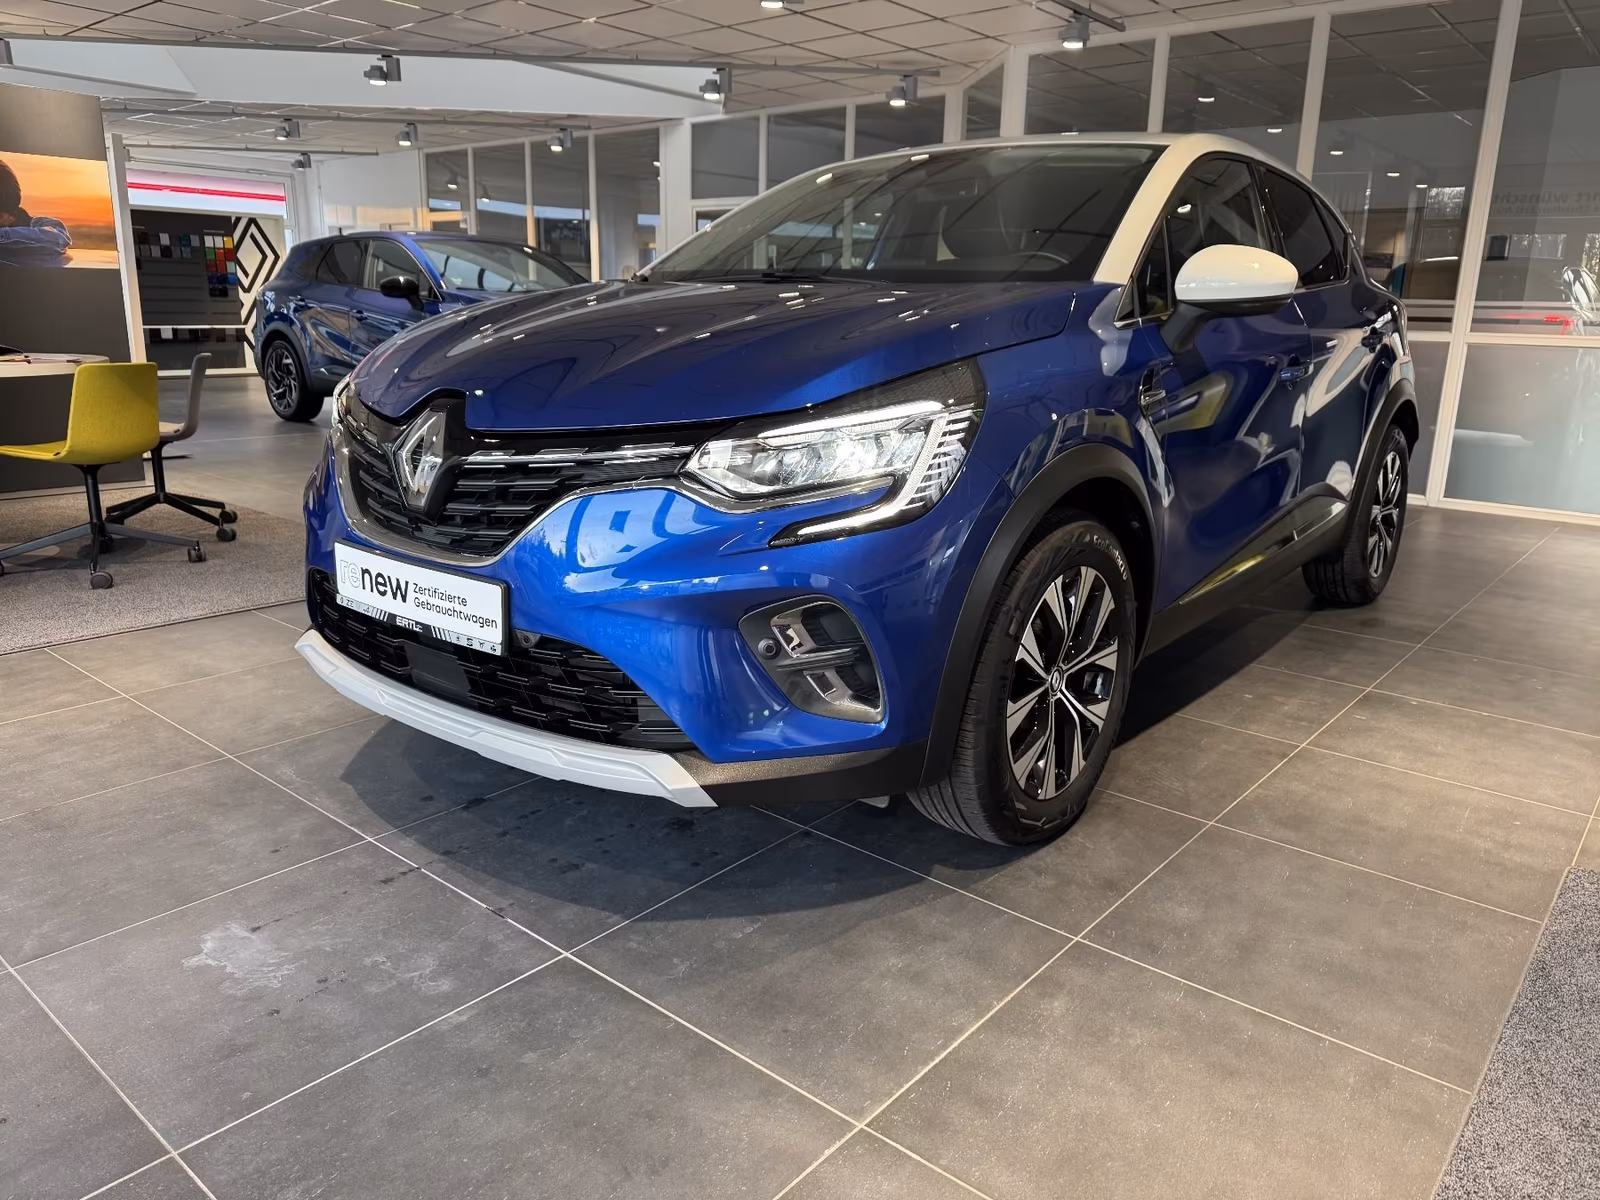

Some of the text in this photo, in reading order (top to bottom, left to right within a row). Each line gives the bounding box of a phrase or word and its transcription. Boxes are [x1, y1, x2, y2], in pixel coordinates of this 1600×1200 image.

[339, 559, 409, 603] renew
[413, 582, 468, 607] Zertifizierte
[413, 598, 498, 629] Gebrauchtwagen
